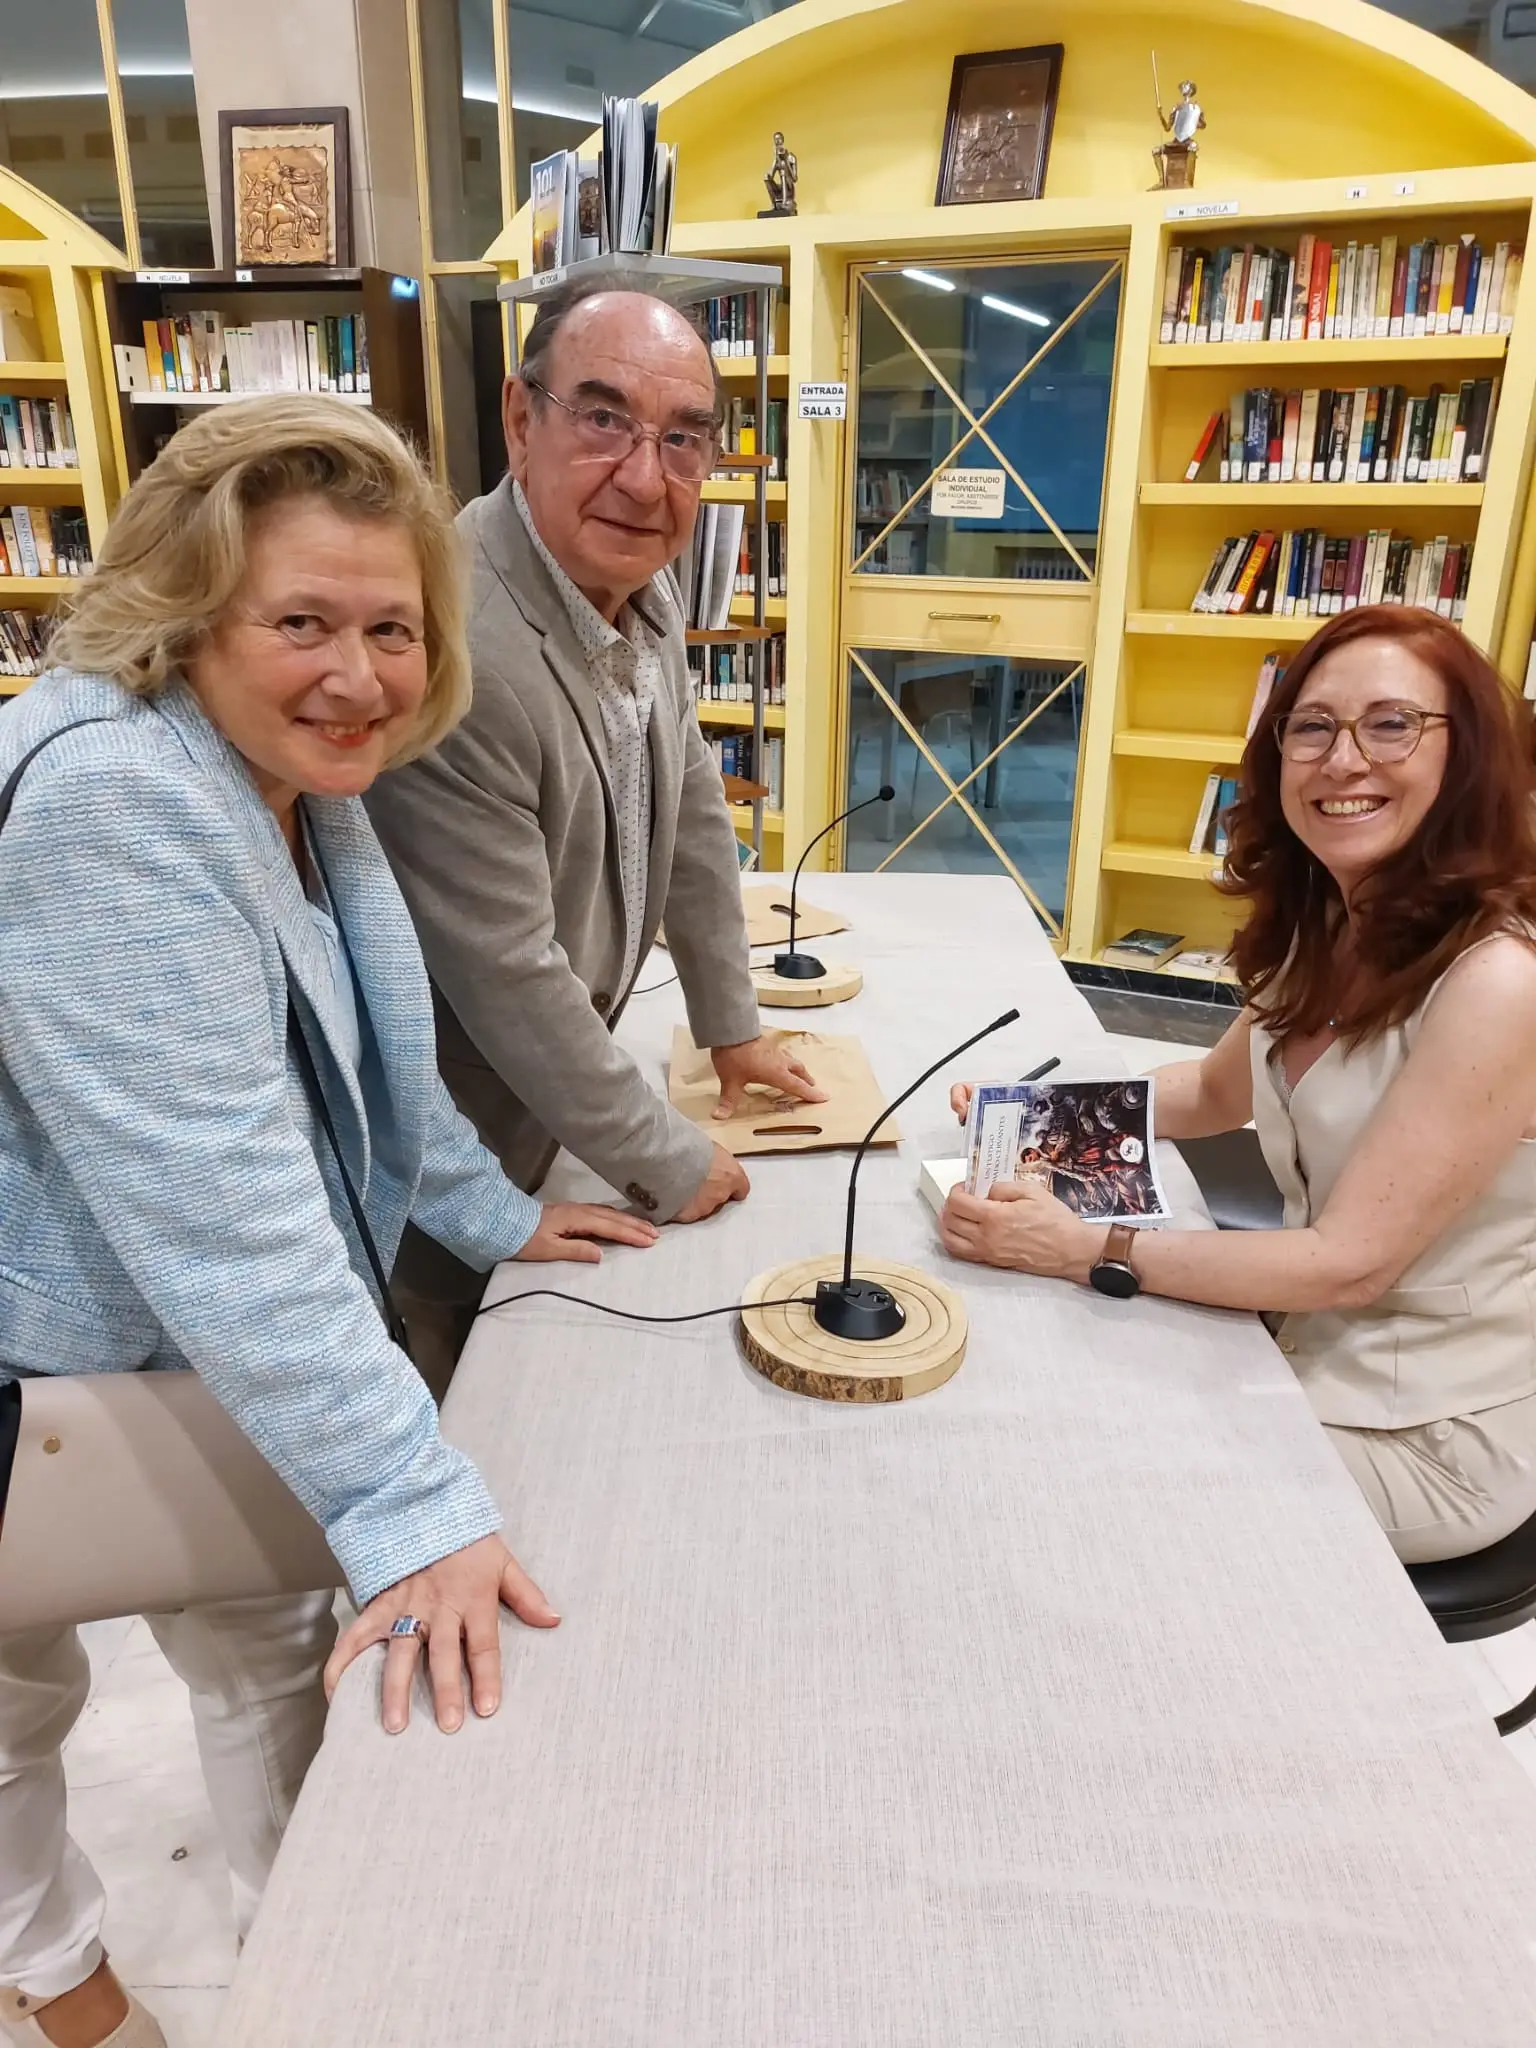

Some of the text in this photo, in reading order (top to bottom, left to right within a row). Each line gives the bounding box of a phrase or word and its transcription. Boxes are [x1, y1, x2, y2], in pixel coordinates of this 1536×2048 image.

[536, 166, 553, 194] 101
[1353, 189, 1361, 198] H
[1196, 204, 1229, 215] NOVELA
[801, 386, 844, 395] ENTRADA
[803, 406, 841, 416] SALA 3
[969, 476, 1001, 484] ESTUDIO
[949, 485, 988, 493] INDIVIDUAL
[995, 1116, 1005, 1158] CERVANTES
